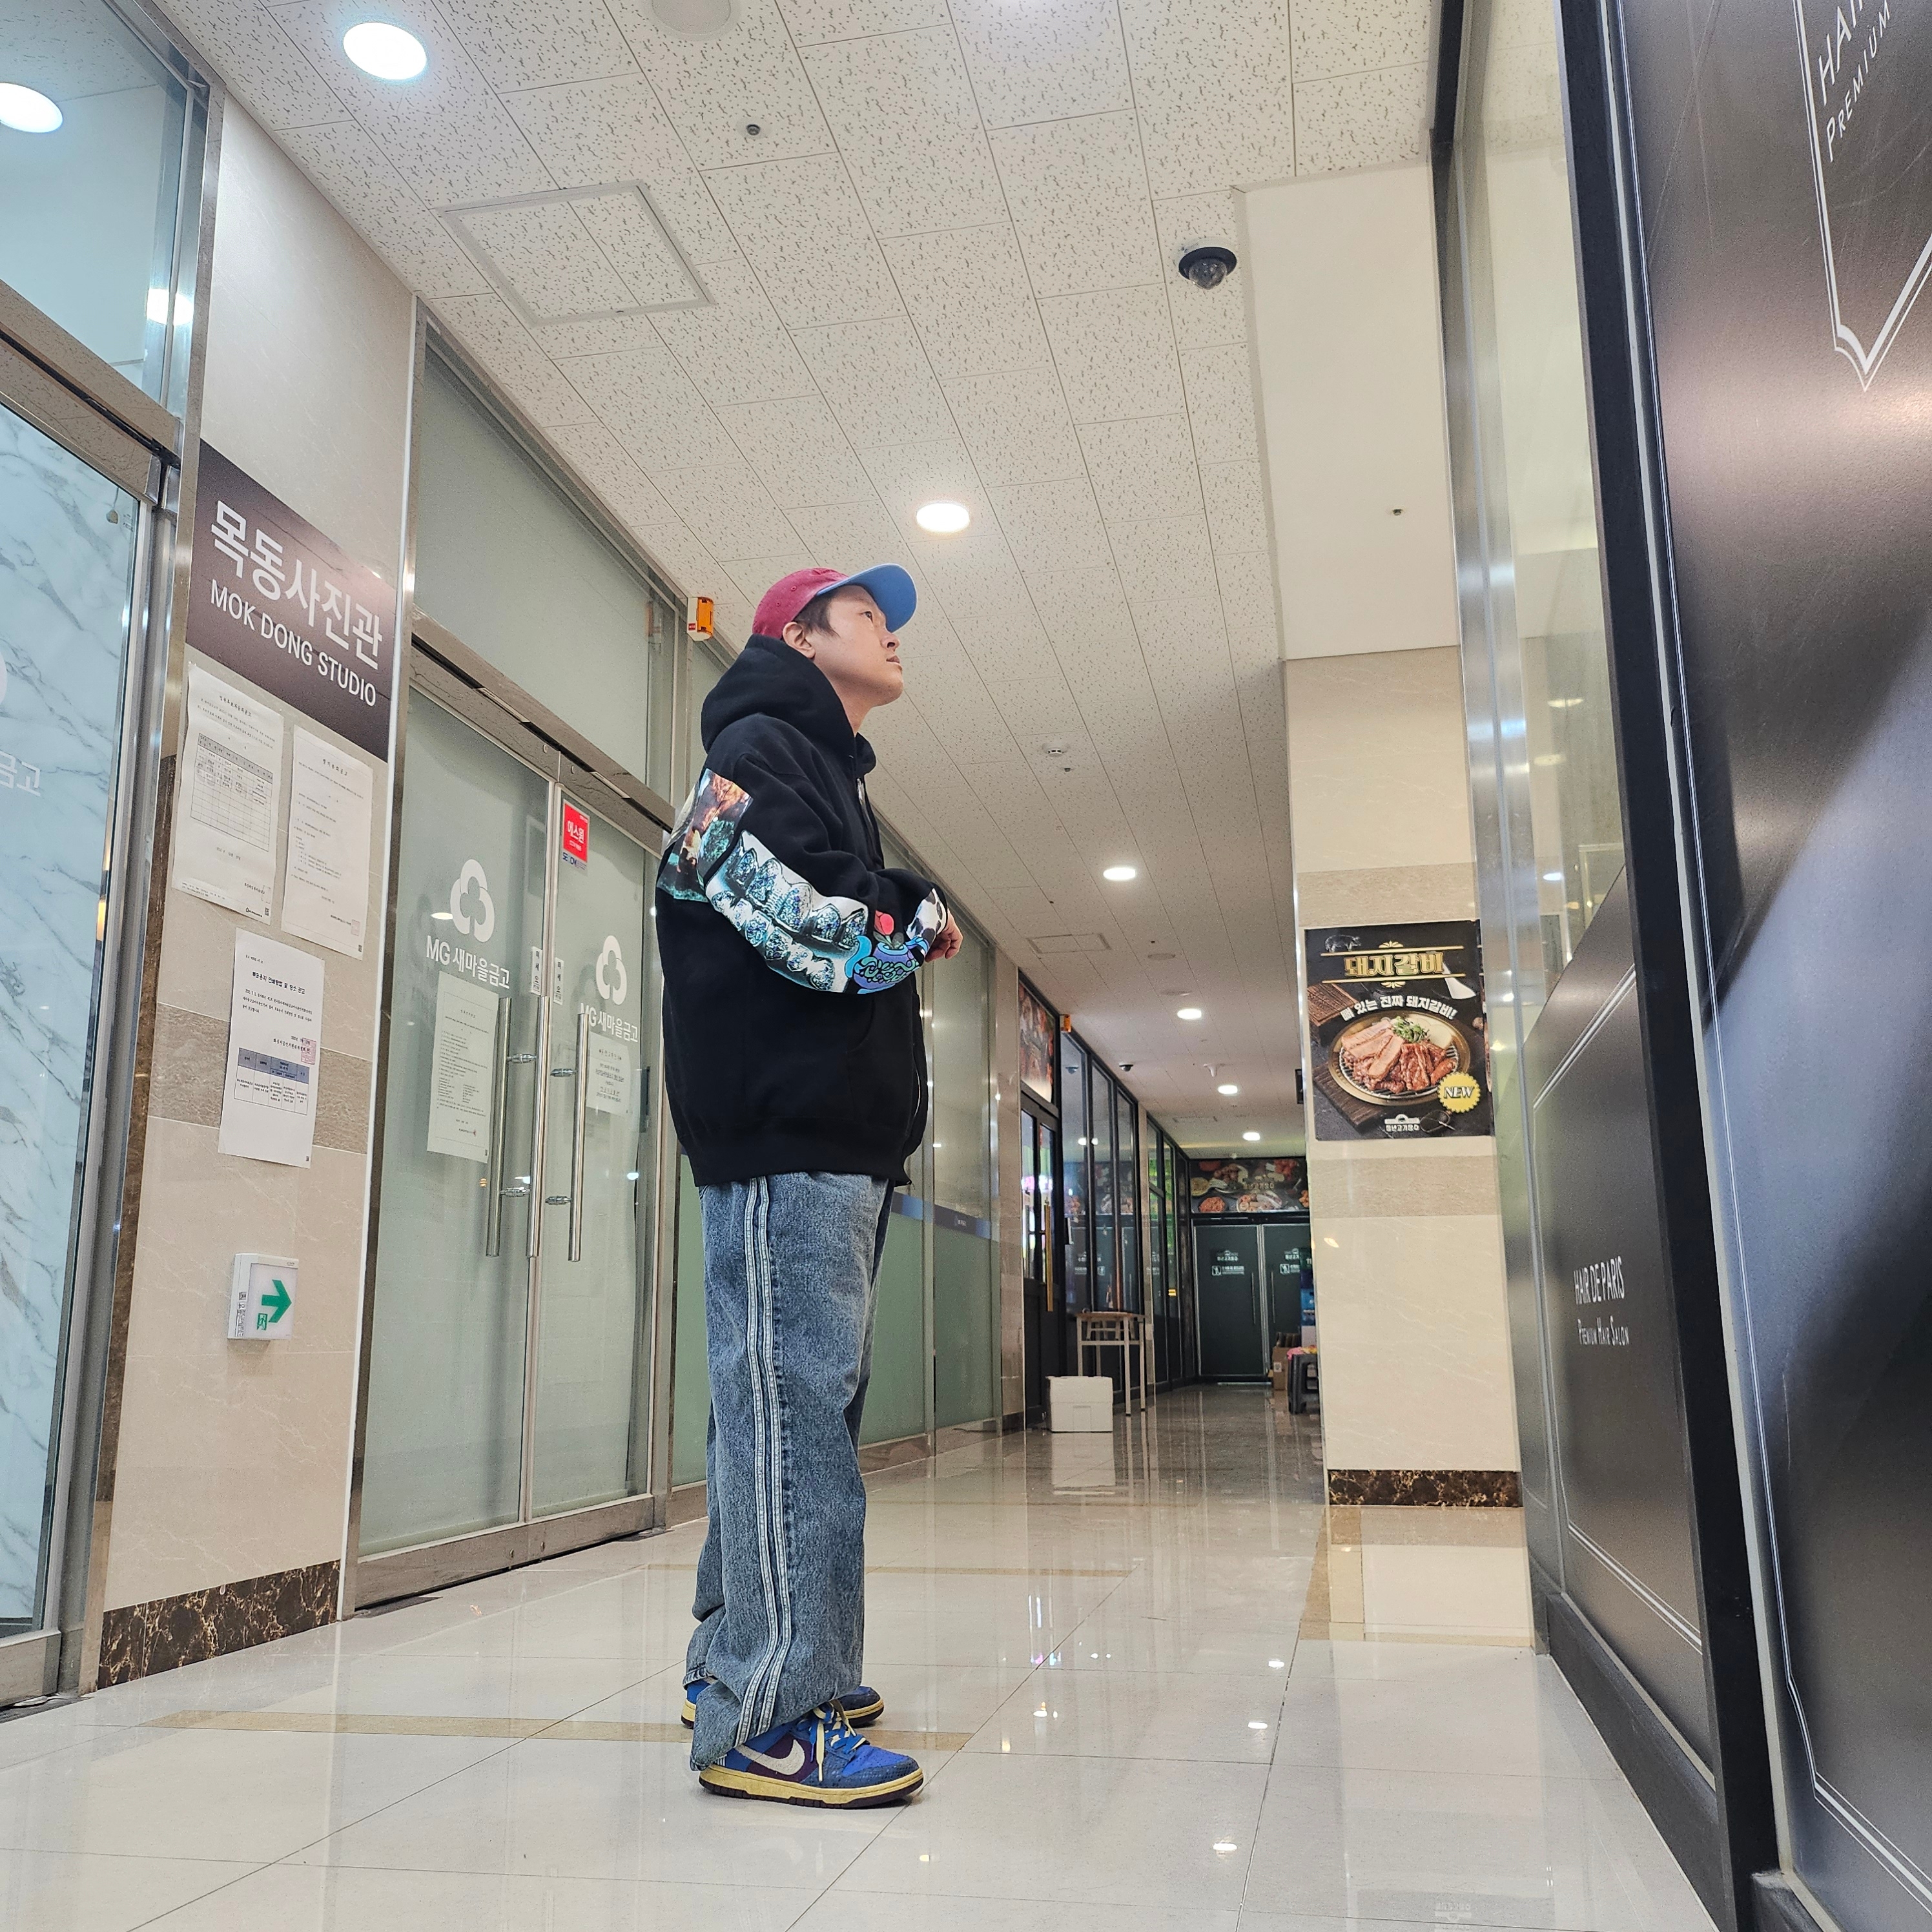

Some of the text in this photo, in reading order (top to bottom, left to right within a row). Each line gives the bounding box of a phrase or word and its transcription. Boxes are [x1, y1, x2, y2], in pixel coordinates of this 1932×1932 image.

[1826, 0, 1891, 163] PREMIUM
[211, 500, 383, 670] 목동사진관
[211, 579, 376, 707] MOK DONG STUDIO
[426, 934, 510, 989] MG 새마을금고
[1344, 951, 1446, 978] 돼지갈비
[598, 1011, 639, 1043] 새마을금고
[1354, 999, 1379, 1014] 있는
[1379, 995, 1404, 1009] 진짜
[1406, 995, 1458, 1020] 돼지갈비!
[1443, 1085, 1475, 1100] NEW
[1589, 1263, 1602, 1303] DE
[1600, 1255, 1625, 1301] PARIS
